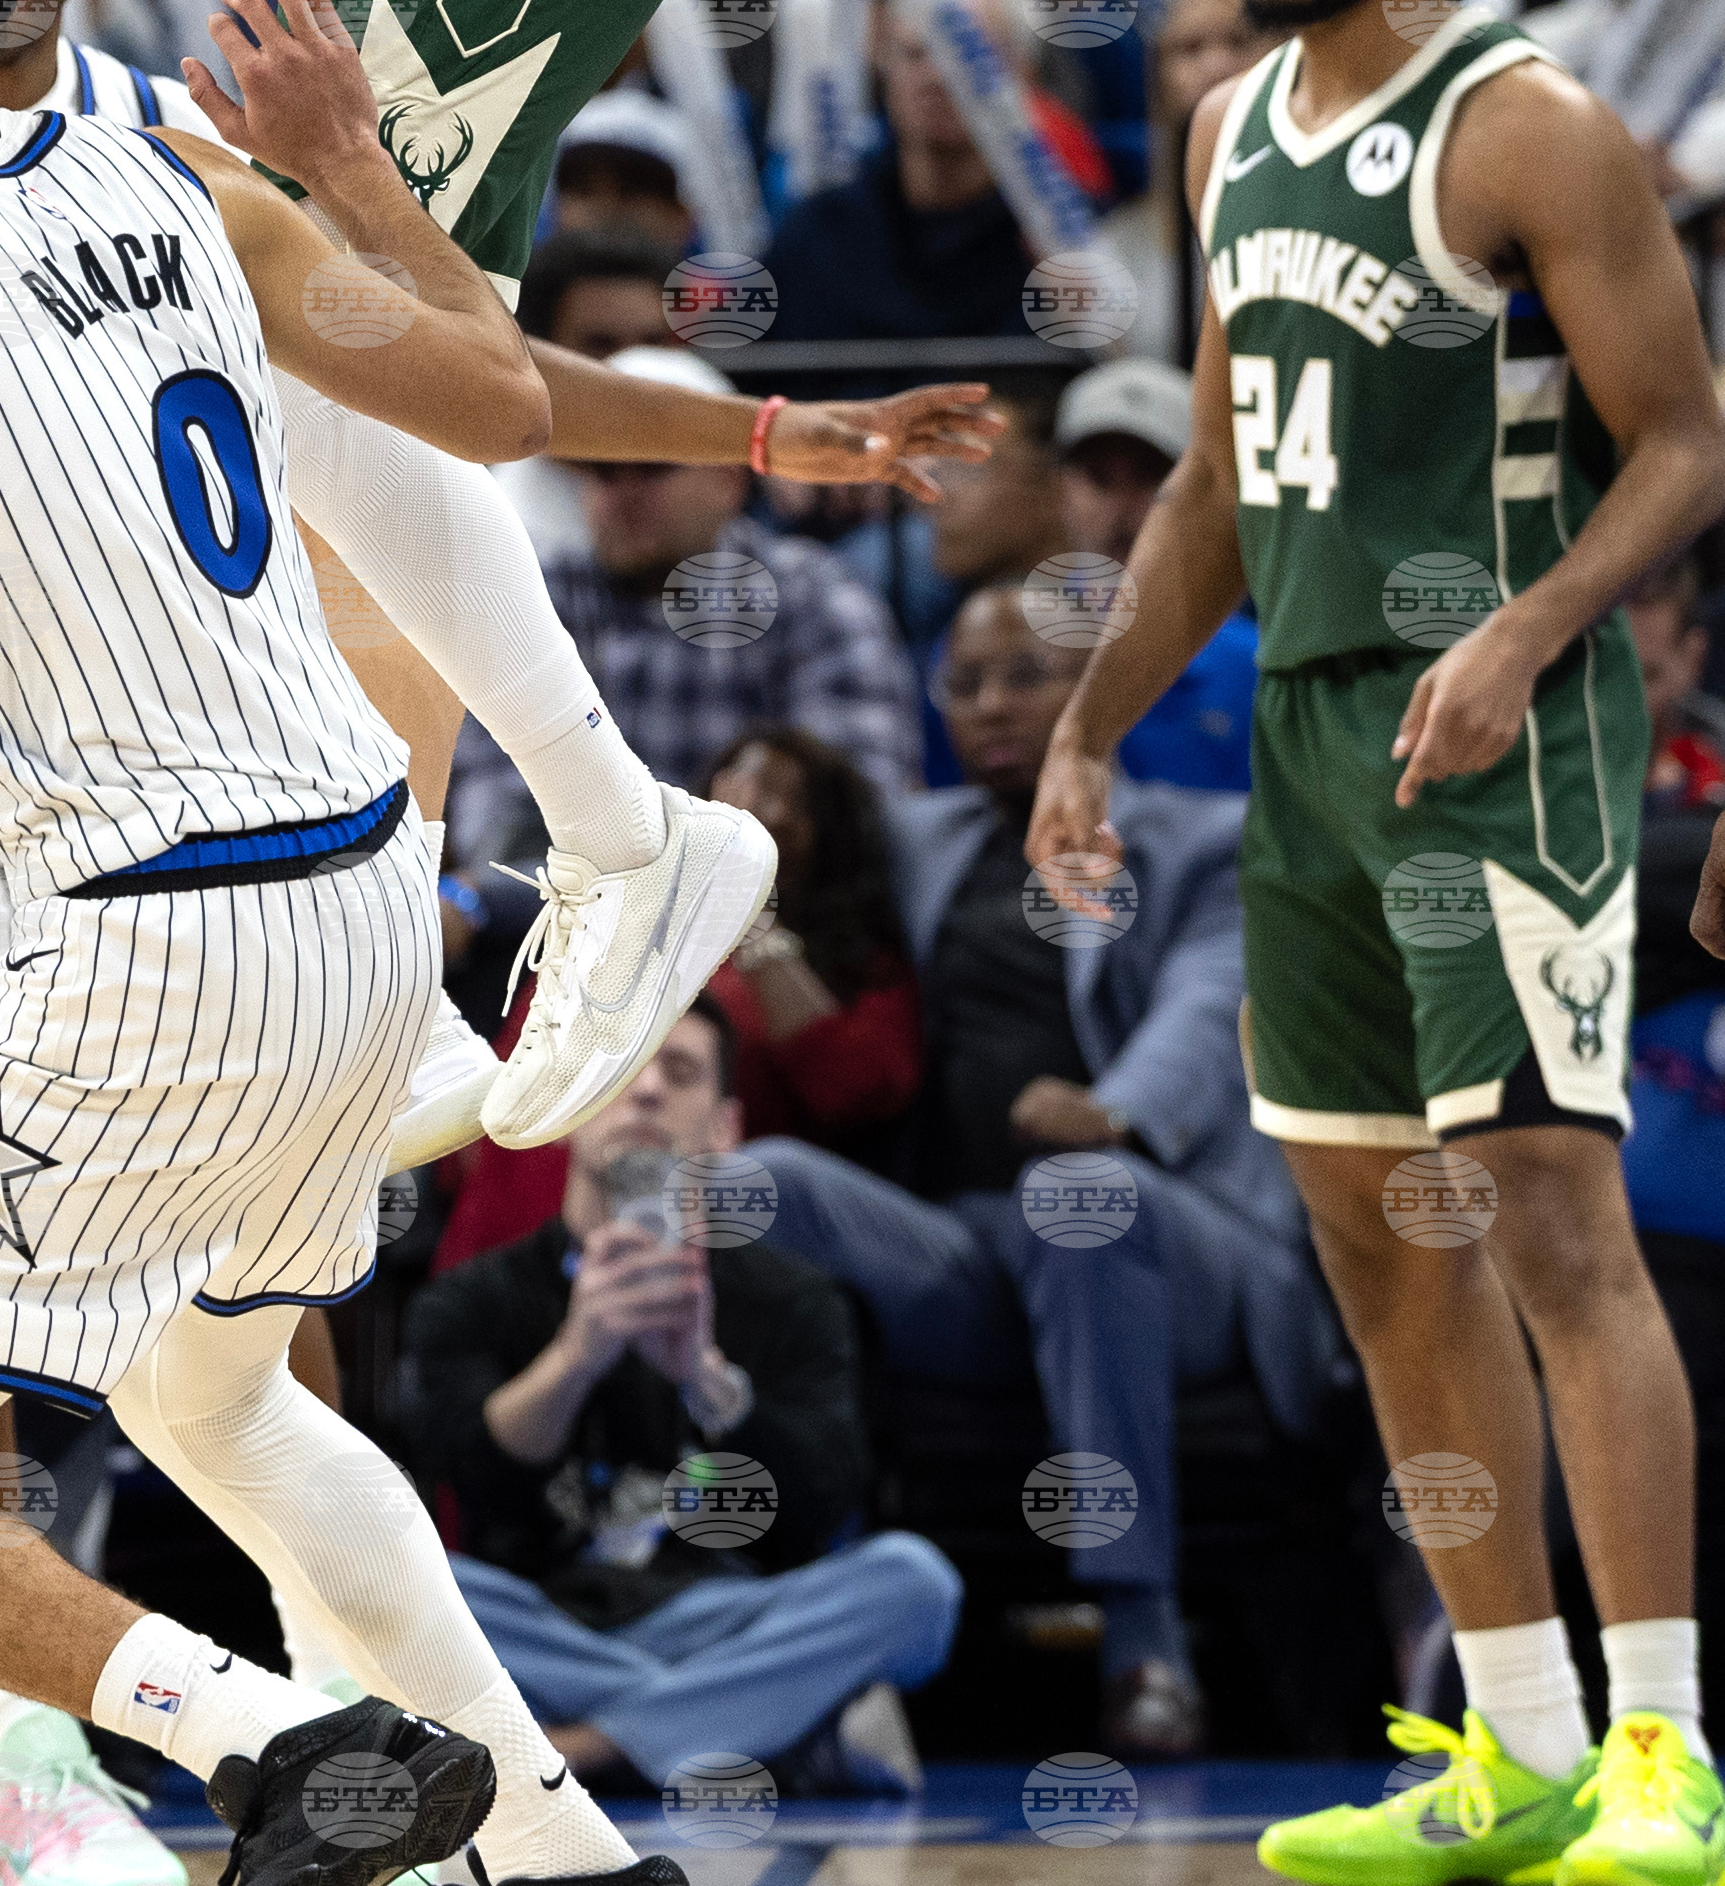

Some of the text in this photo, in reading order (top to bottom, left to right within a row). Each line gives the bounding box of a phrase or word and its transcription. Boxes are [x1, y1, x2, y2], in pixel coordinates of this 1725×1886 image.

[19, 232, 193, 340] BLACK
[151, 367, 273, 600] 0
[1229, 353, 1339, 513] 24
